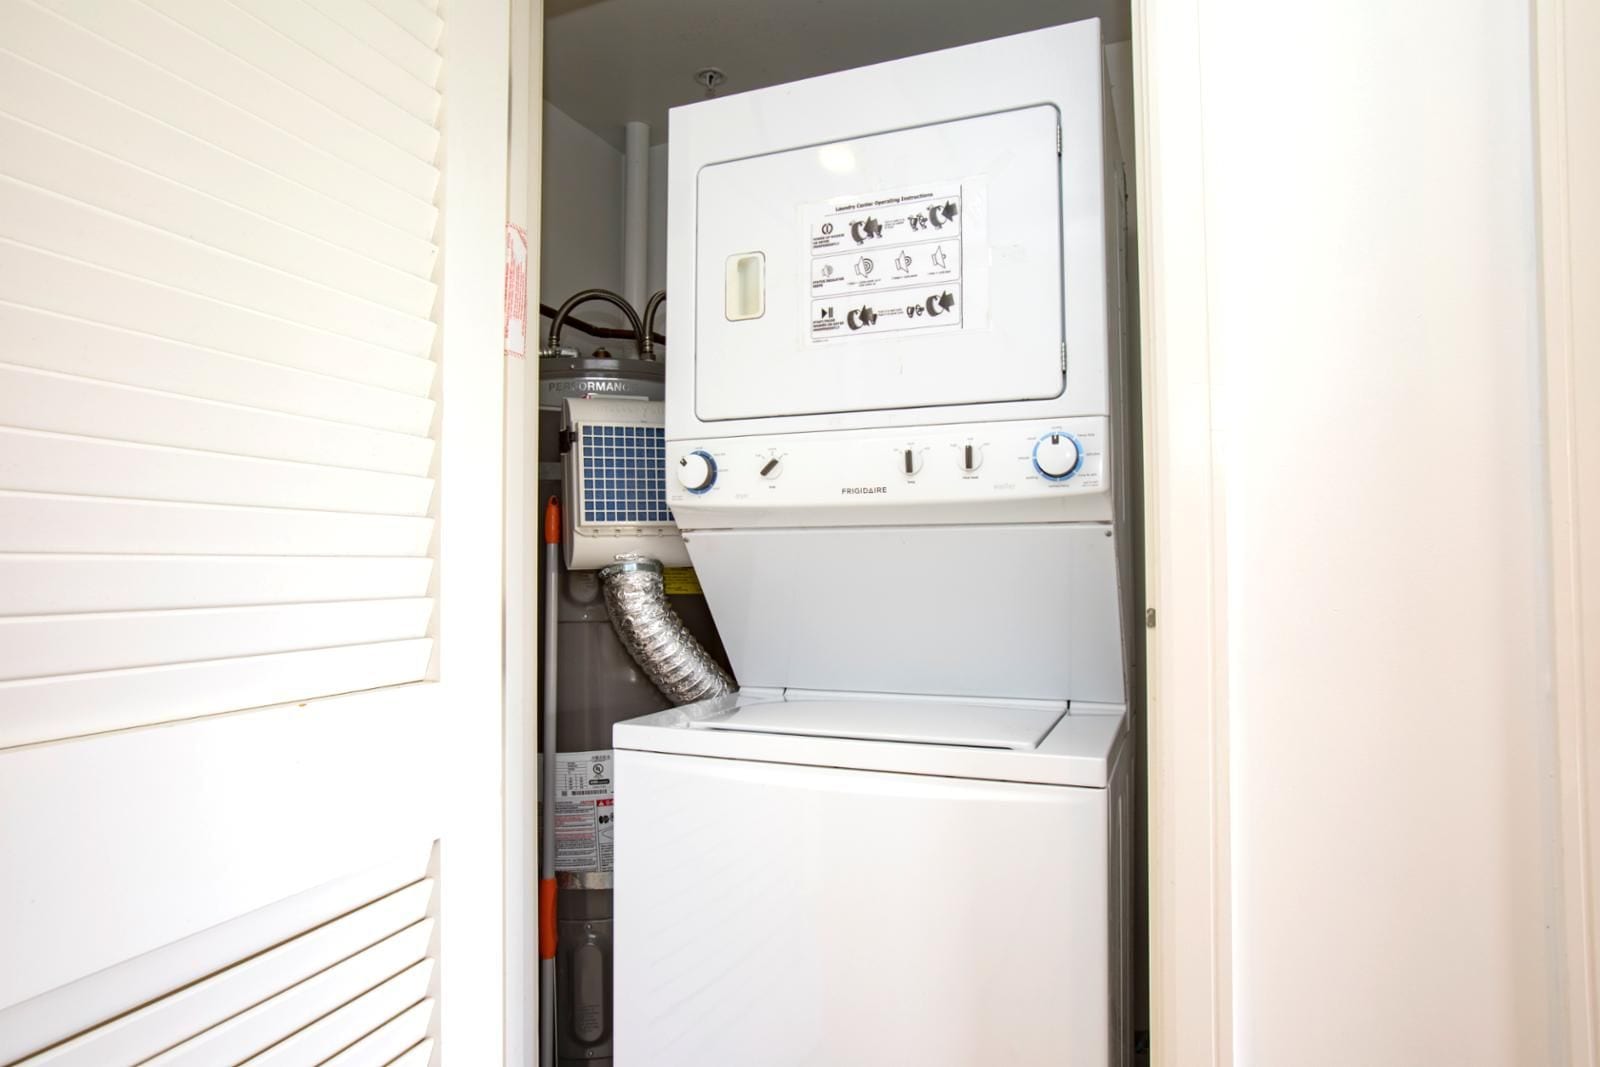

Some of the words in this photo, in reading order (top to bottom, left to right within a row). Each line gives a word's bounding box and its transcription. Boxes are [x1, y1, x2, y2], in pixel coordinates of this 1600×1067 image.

[835, 204, 855, 212] Laundry
[856, 201, 873, 209] Center
[874, 197, 901, 206] Operating
[901, 192, 934, 201] Instructions
[548, 381, 636, 393] PERFORMANC
[841, 486, 888, 495] FRIGIDAIRE
